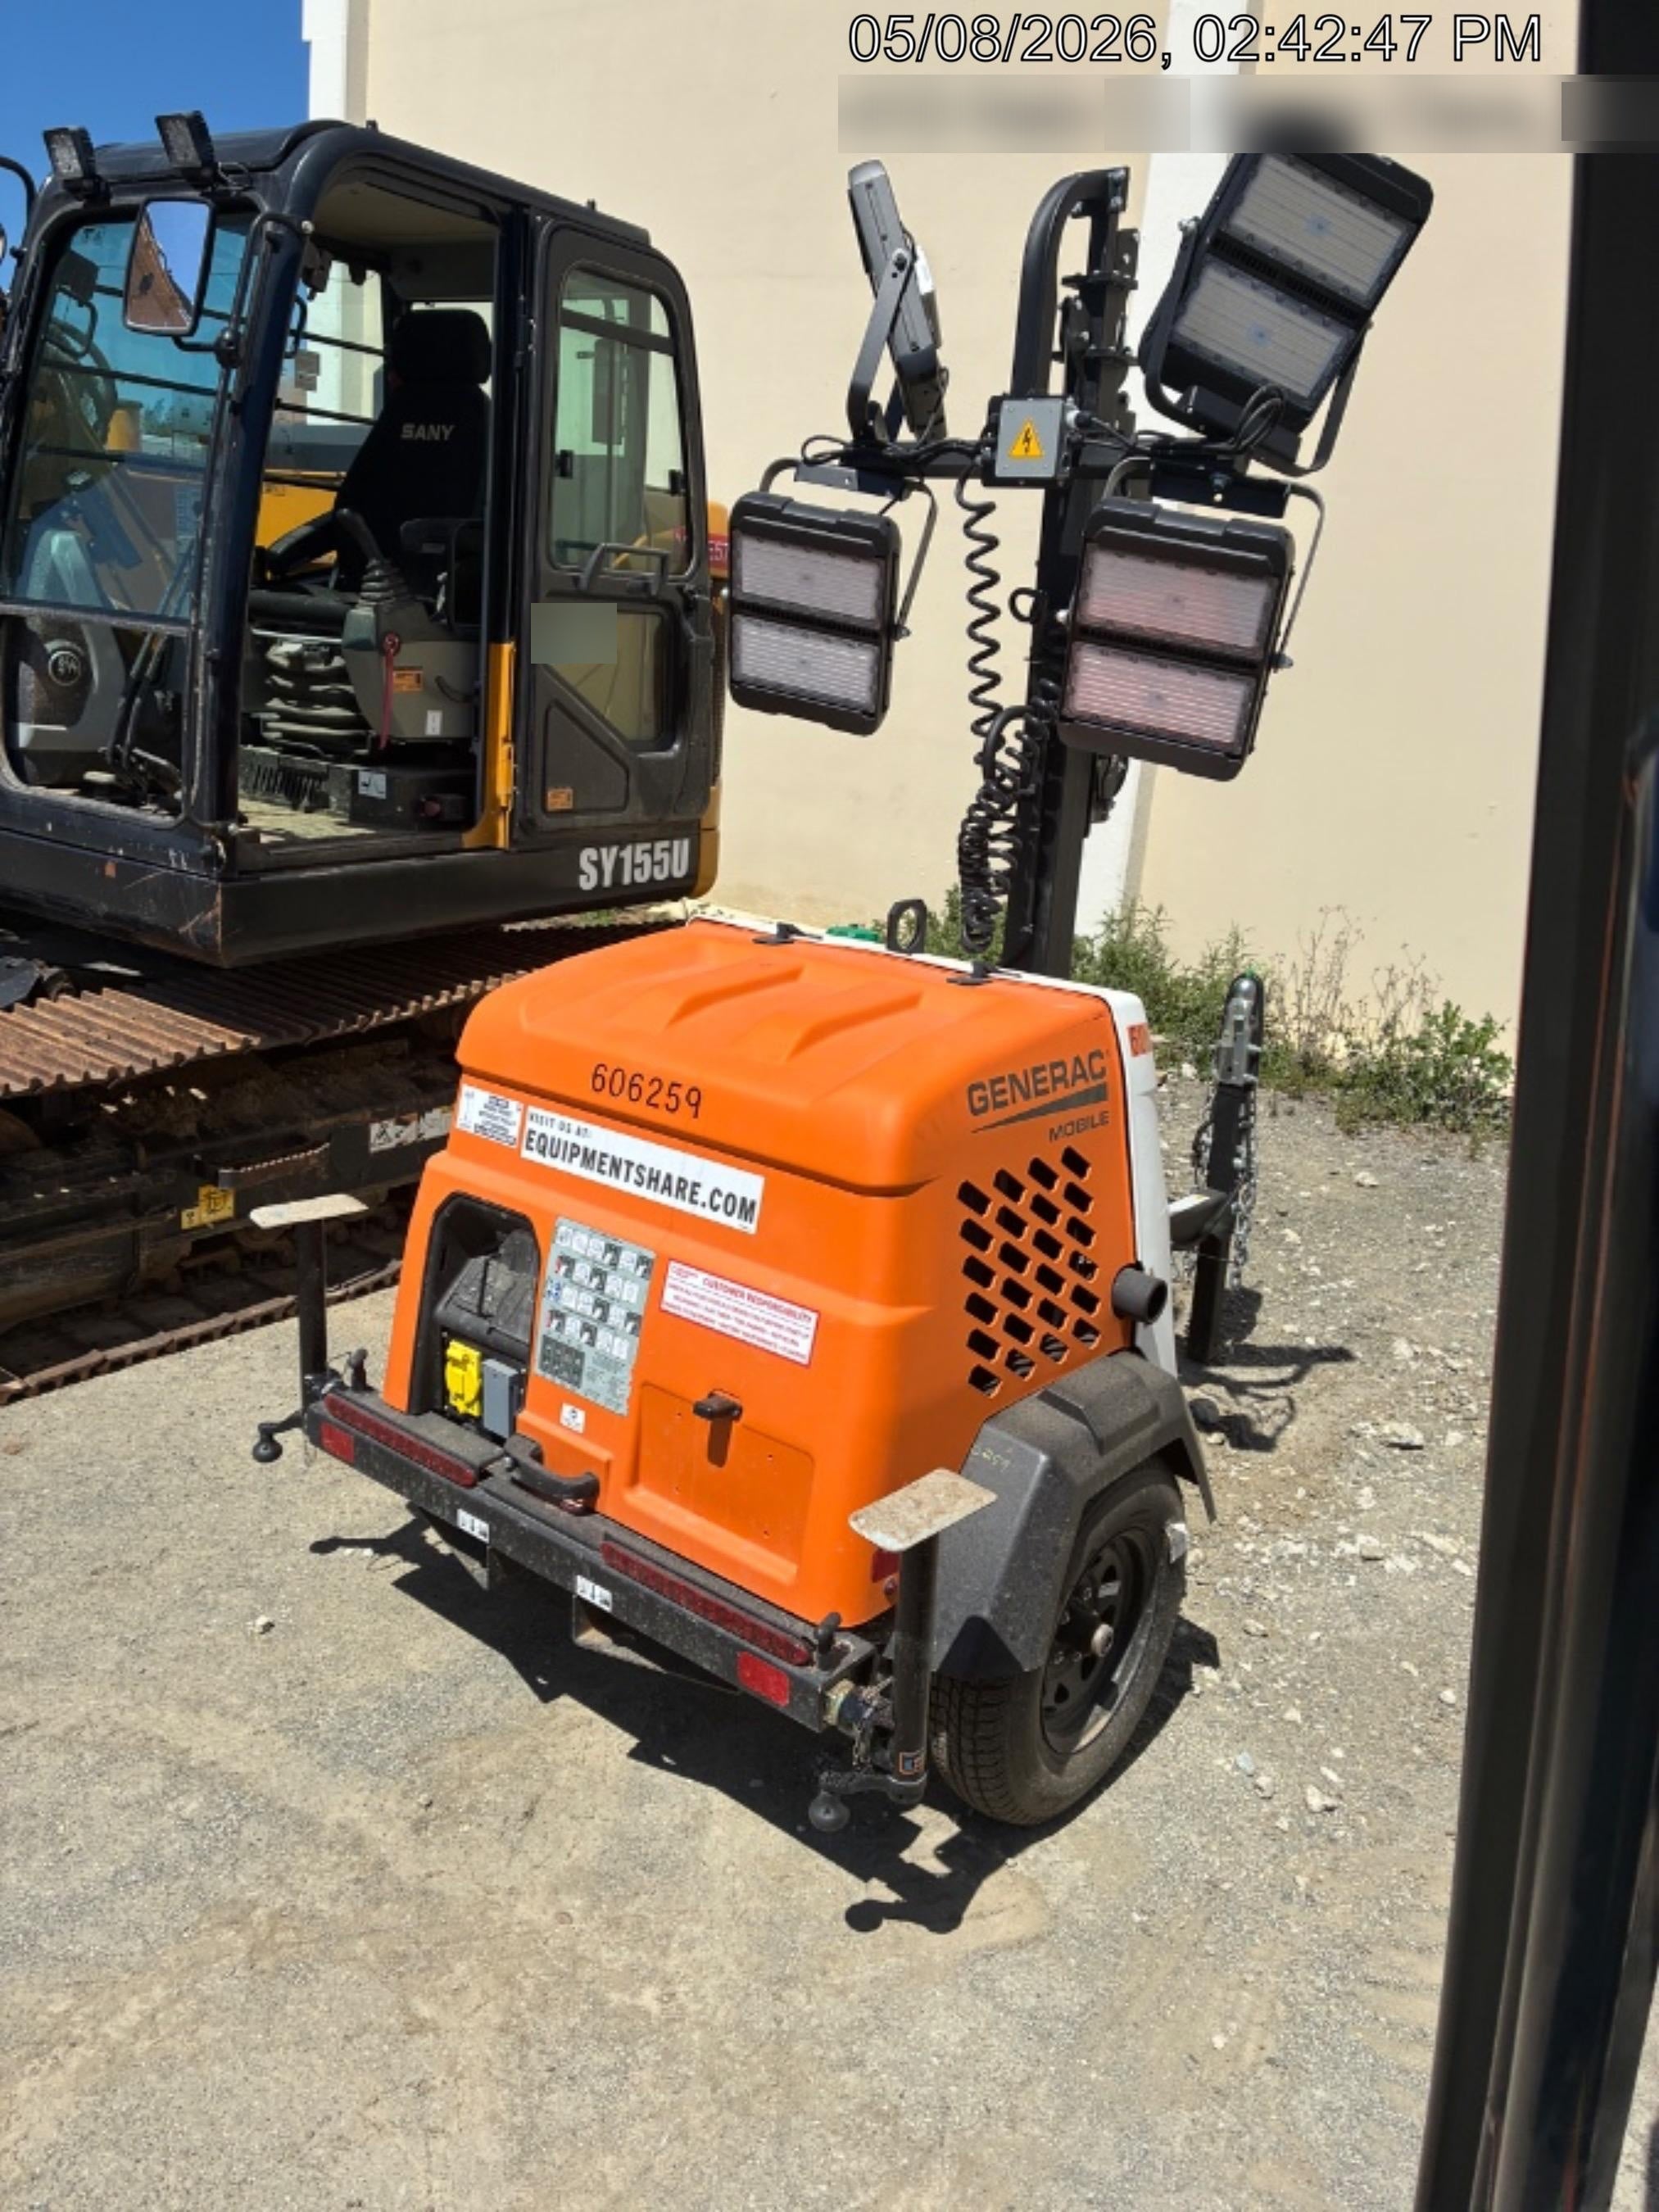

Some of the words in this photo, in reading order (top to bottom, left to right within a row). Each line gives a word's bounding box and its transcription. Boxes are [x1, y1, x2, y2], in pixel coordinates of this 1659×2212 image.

[401, 423, 456, 441] SANY
[579, 838, 690, 891] SY155U
[592, 1063, 702, 1119] 606259
[968, 1049, 1106, 1116] GENERAC
[529, 1113, 556, 1128] VISIT
[559, 1120, 572, 1134] US
[1049, 1111, 1109, 1143] MOBILE
[525, 1130, 756, 1225] EQUIPMENTSHARE.COM
